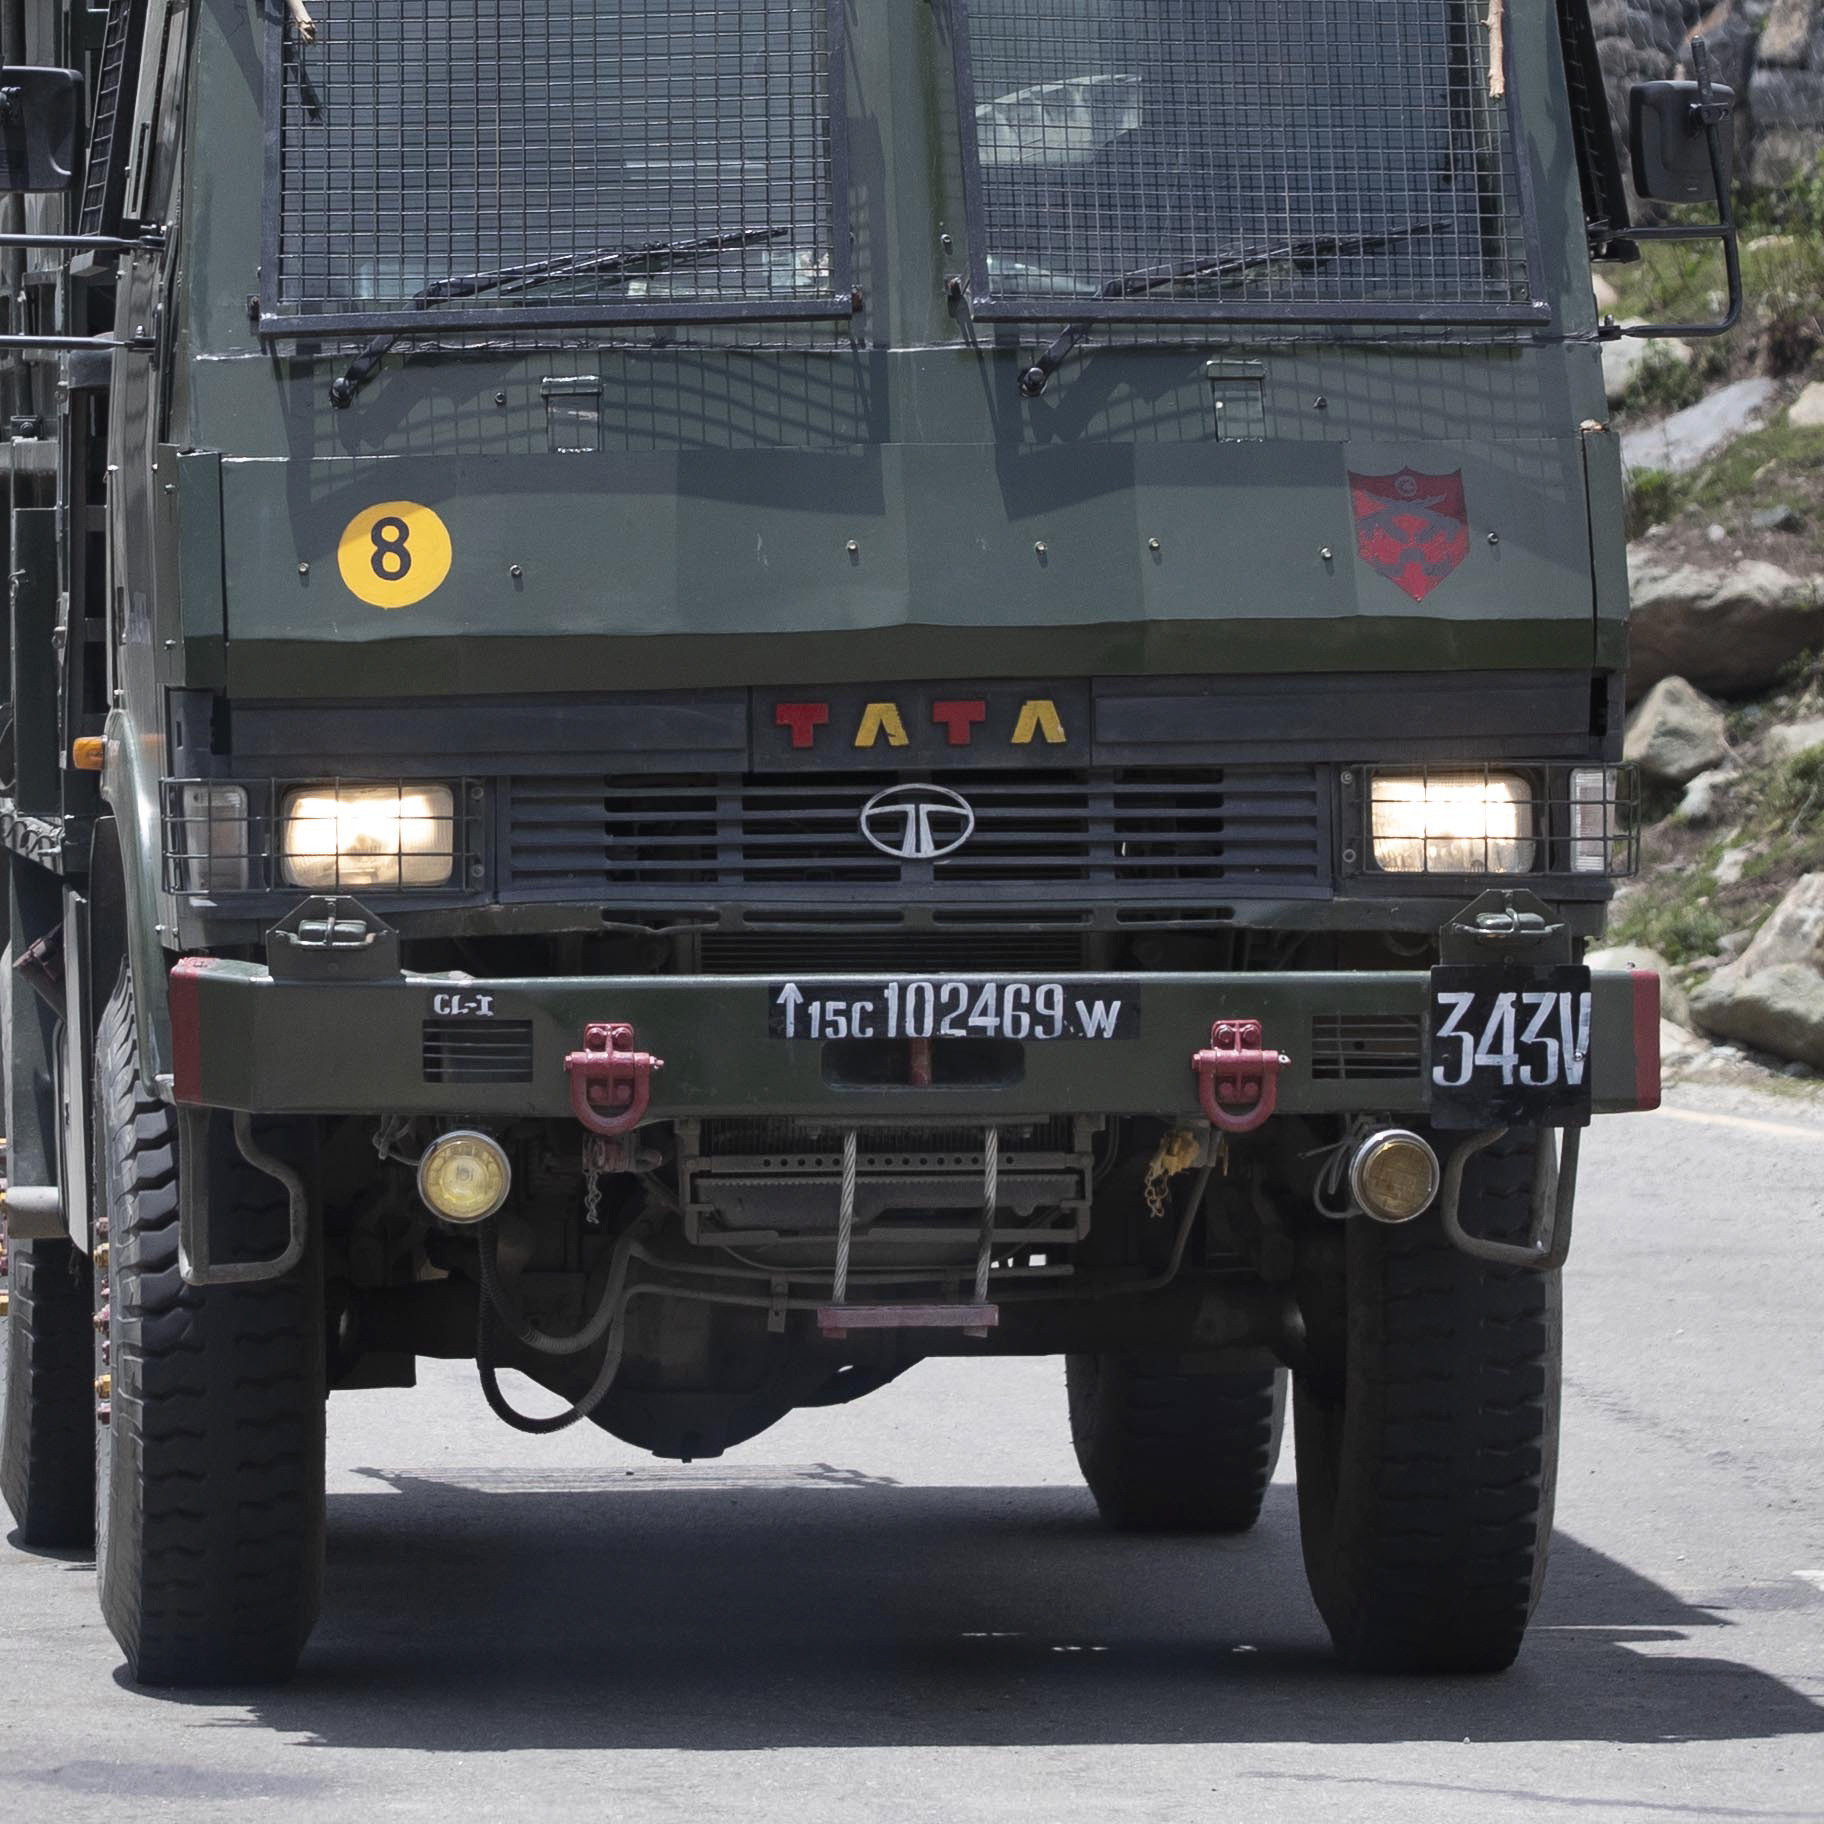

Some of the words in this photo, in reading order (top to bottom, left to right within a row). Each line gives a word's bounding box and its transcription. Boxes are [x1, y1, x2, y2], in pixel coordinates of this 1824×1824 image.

[371, 517, 412, 581] 8
[775, 699, 1068, 749] TATA
[433, 993, 495, 1017] CL-I
